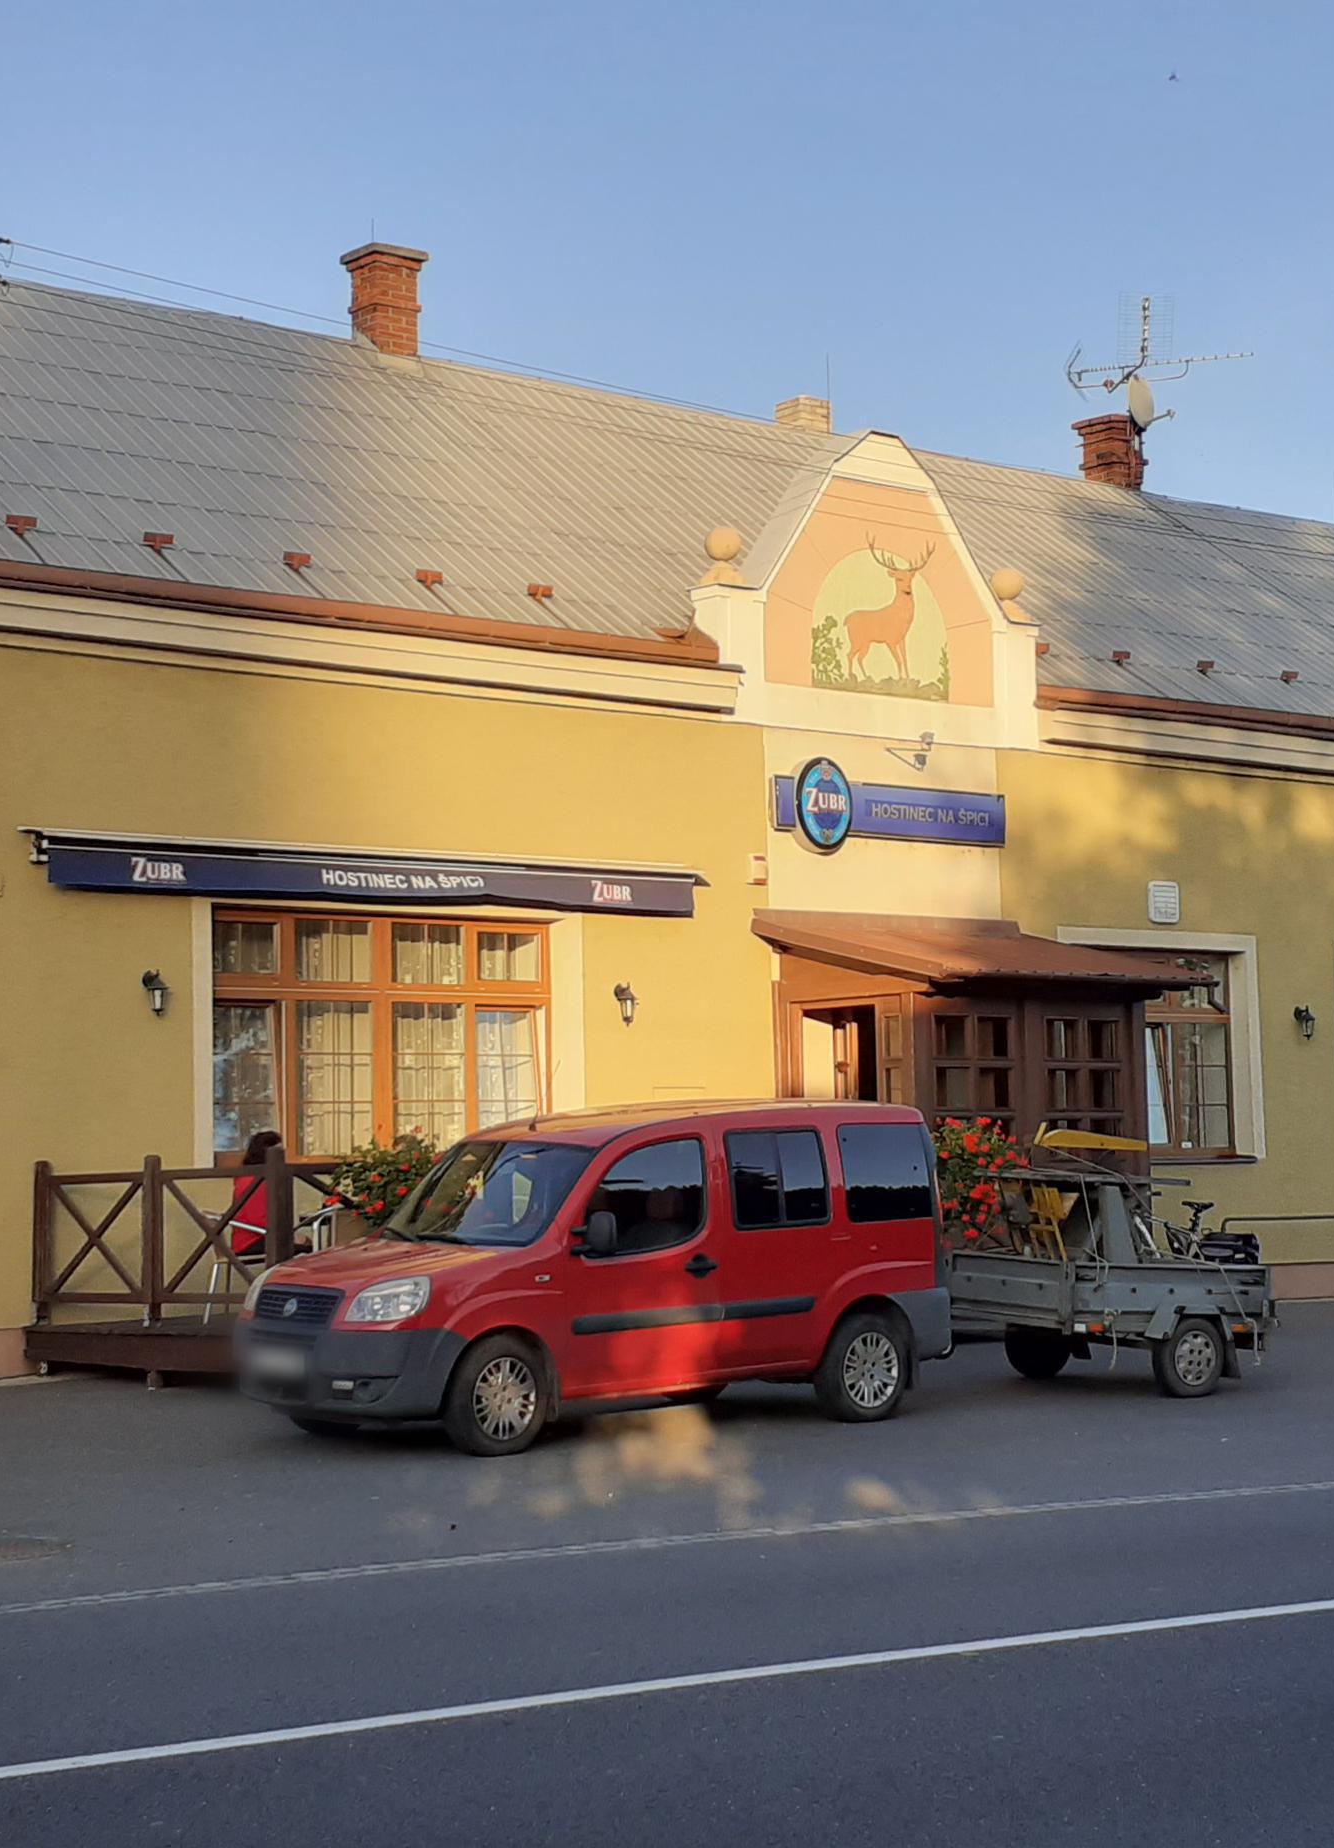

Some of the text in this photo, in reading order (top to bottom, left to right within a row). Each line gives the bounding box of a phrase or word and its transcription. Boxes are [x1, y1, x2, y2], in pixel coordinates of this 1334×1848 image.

[806, 788, 847, 812] ZUBR
[871, 803, 990, 828] HOSTINEC NA ŠPICI
[130, 856, 186, 882] ZUBR
[321, 868, 484, 889] HOSTINEC NA ŠPICI
[590, 879, 633, 903] ZUBR
